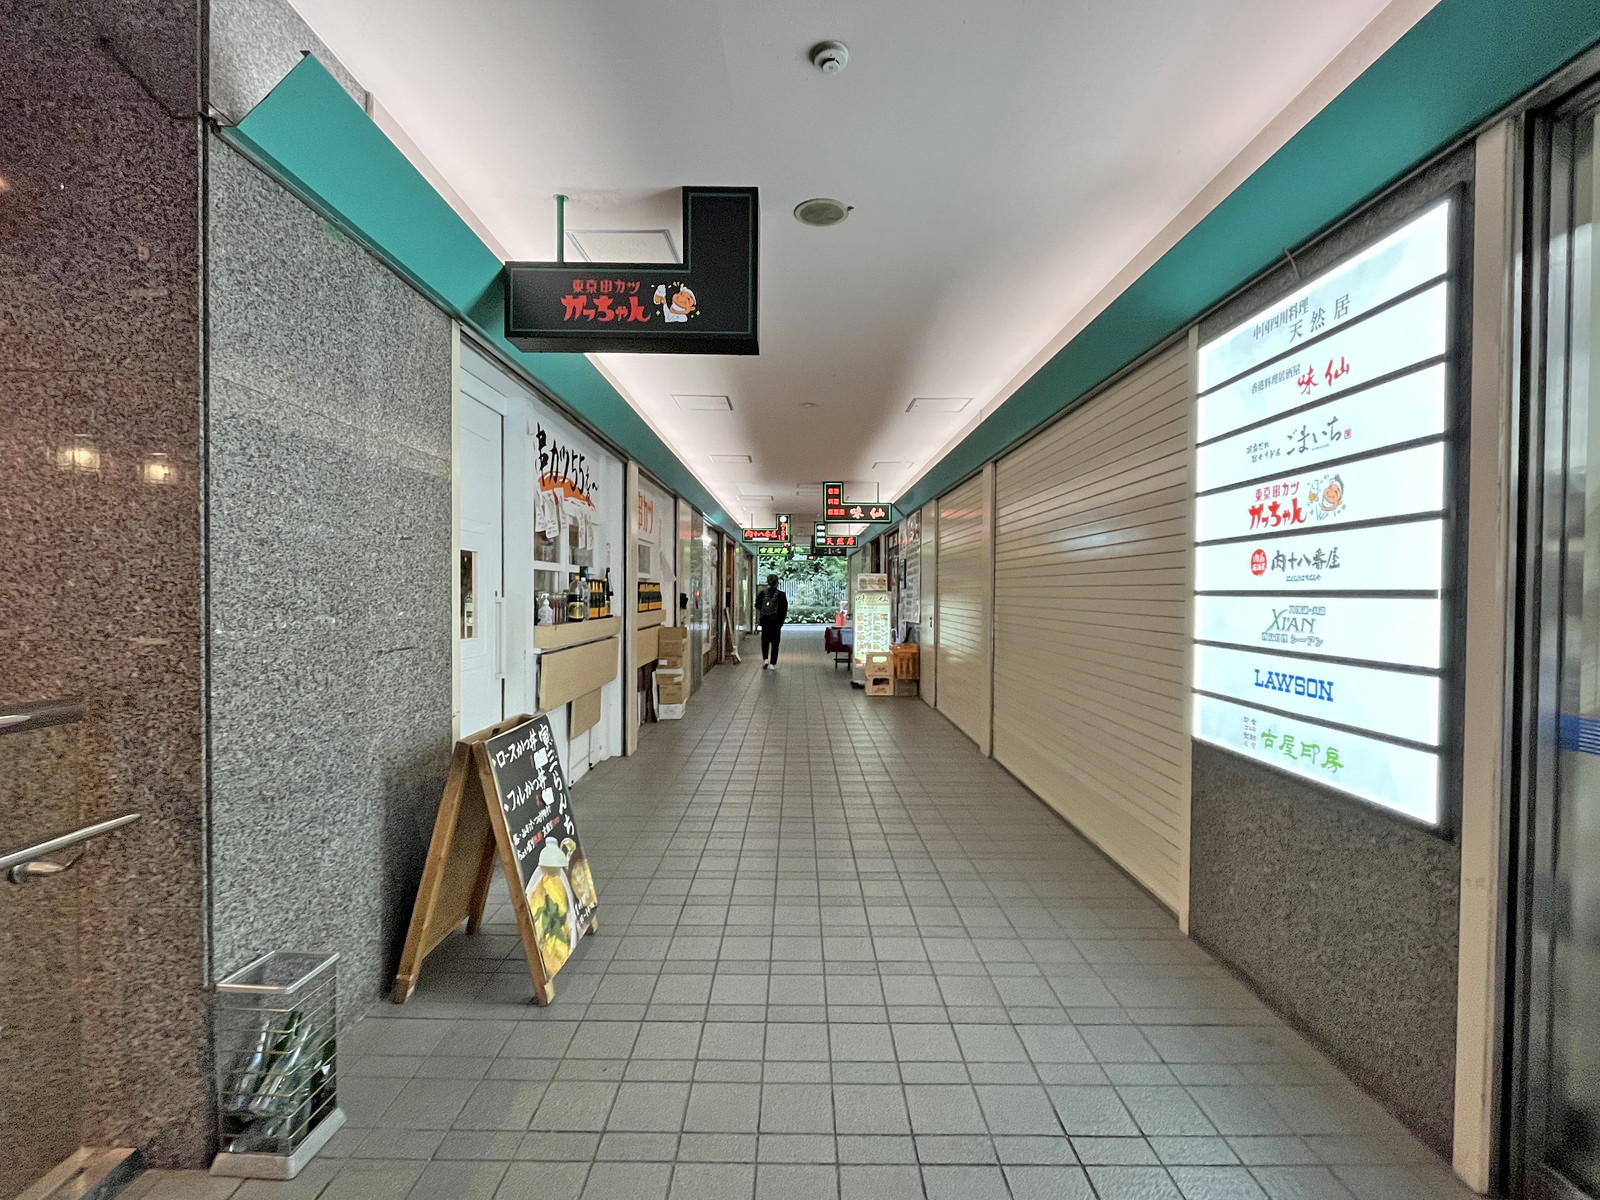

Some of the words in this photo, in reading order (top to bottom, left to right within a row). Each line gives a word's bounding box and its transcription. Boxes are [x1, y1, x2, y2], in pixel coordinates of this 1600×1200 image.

[572, 279, 641, 295] 東京串カツ
[1252, 297, 1309, 341] 中国四川料理
[1288, 293, 1351, 344] 天然居
[1251, 363, 1301, 395] 香港料理居酒屋
[1297, 355, 1350, 395] 味仙
[1286, 416, 1343, 456] ごまいち
[1254, 481, 1300, 502] 東京串カツ
[849, 505, 886, 519] 味仙
[1271, 546, 1340, 573] 肉十八番屋
[1254, 668, 1334, 702] LAWSON
[496, 728, 538, 769] ロースかつ丼
[1260, 728, 1345, 774] 古屋印房
